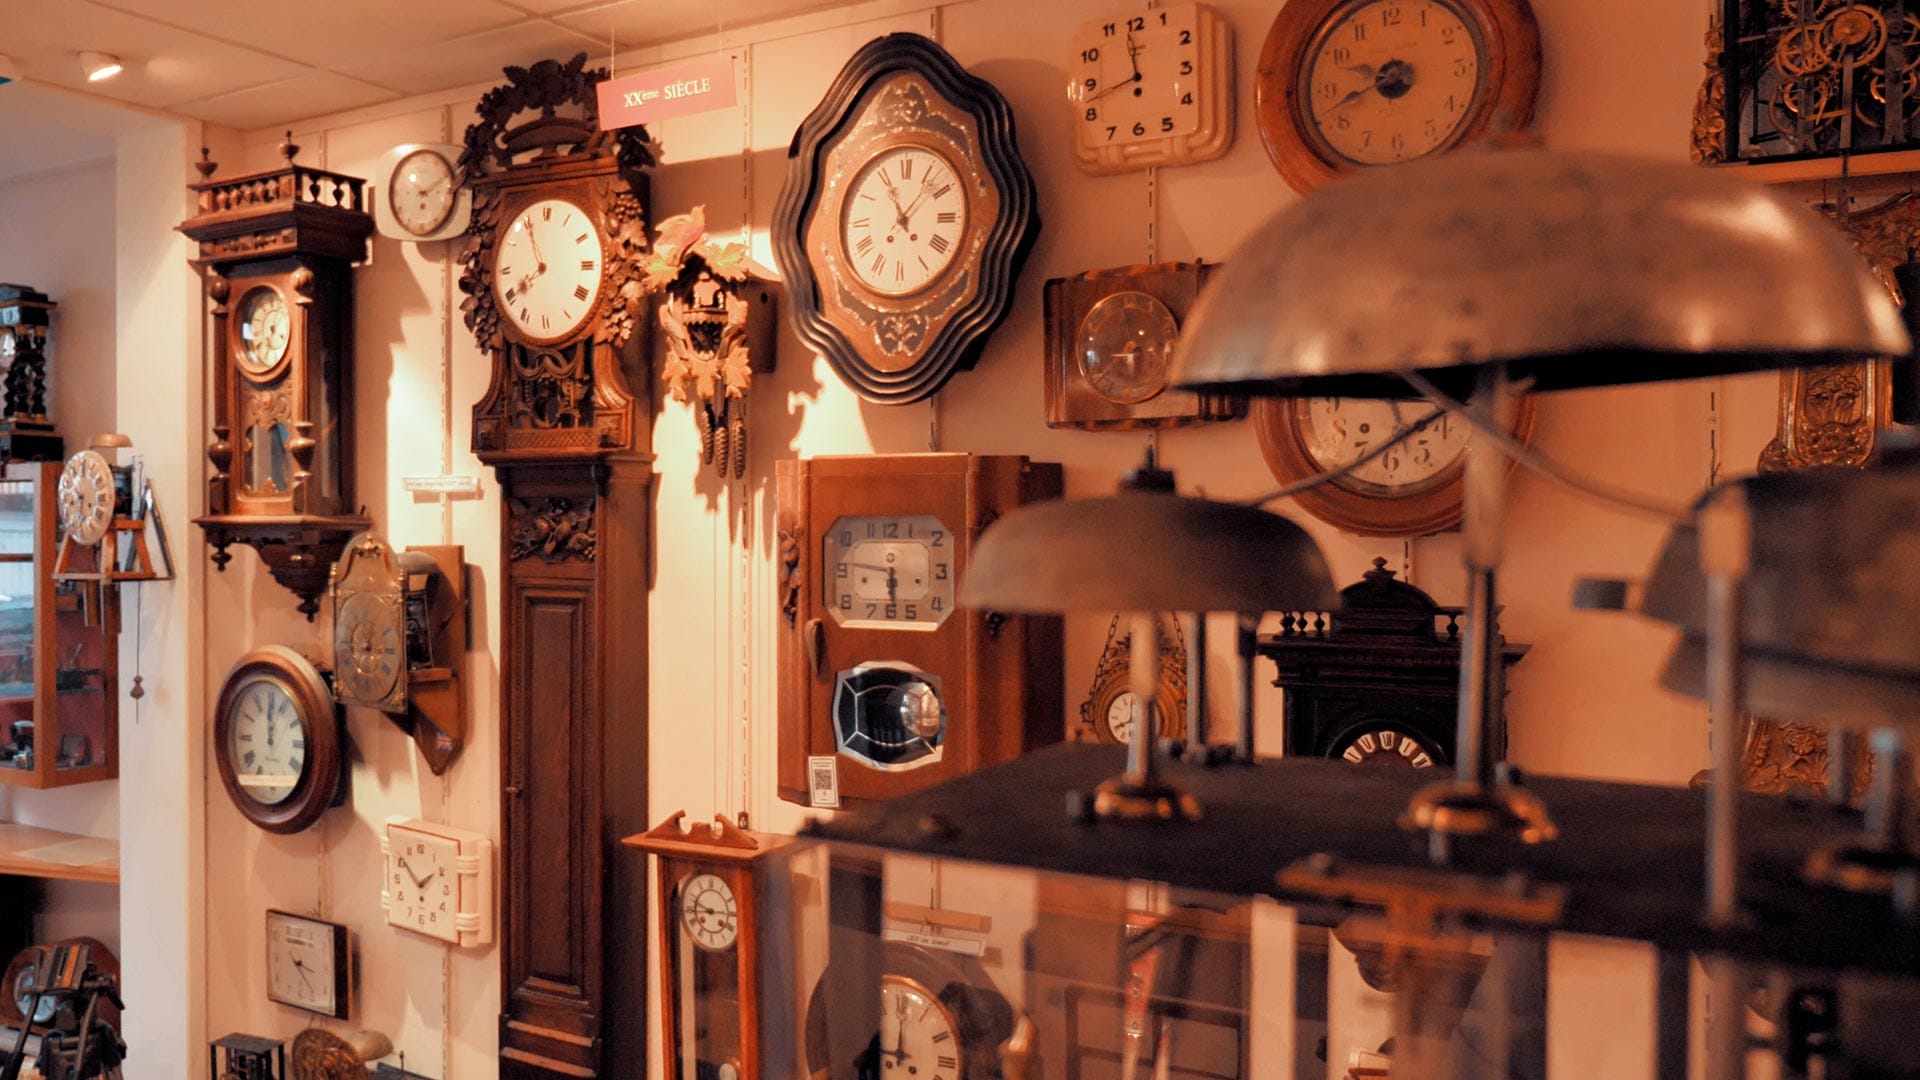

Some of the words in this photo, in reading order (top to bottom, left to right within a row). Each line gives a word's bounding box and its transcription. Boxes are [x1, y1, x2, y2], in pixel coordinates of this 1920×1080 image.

[1127, 17, 1144, 32] 12
[1160, 12, 1167, 26] 1
[1382, 7, 1401, 27] 12
[1420, 9, 1427, 27] 1
[1103, 23, 1116, 37] 11
[1179, 30, 1191, 45] 2
[1354, 23, 1366, 42] 11
[1081, 48, 1099, 63] 10
[1333, 48, 1351, 65] 10
[1180, 61, 1193, 75] 3
[624, 89, 659, 108] XXème
[664, 78, 711, 100] SIÈCLE
[1084, 78, 1097, 92] 9
[1324, 81, 1337, 99] 9
[1180, 91, 1193, 105] 4
[1443, 94, 1455, 112] 4
[1085, 107, 1097, 121] 8
[1133, 121, 1145, 136] 6
[1161, 117, 1174, 132] 5
[1337, 115, 1350, 130] 8
[1424, 119, 1437, 138] 5
[1106, 126, 1117, 141] 7
[1361, 130, 1374, 147] 7
[1391, 134, 1404, 151] 6
[1332, 417, 1347, 445] 8
[1433, 414, 1454, 441] 4
[1381, 448, 1400, 473] 6
[840, 530, 853, 547] 10
[866, 523, 876, 538] 11
[882, 522, 899, 539] 12
[907, 523, 913, 539] 1
[931, 530, 944, 548] 2
[836, 562, 848, 579] 9
[935, 563, 948, 580] 3
[840, 593, 852, 611] 8
[930, 595, 944, 613] 4
[865, 603, 877, 619] 7
[884, 603, 897, 620] 6
[904, 604, 917, 620] 5
[443, 884, 450, 896] 3
[407, 905, 413, 918] 7
[439, 901, 446, 912] 4
[418, 913, 426, 926] 6
[937, 1055, 956, 1069] III
